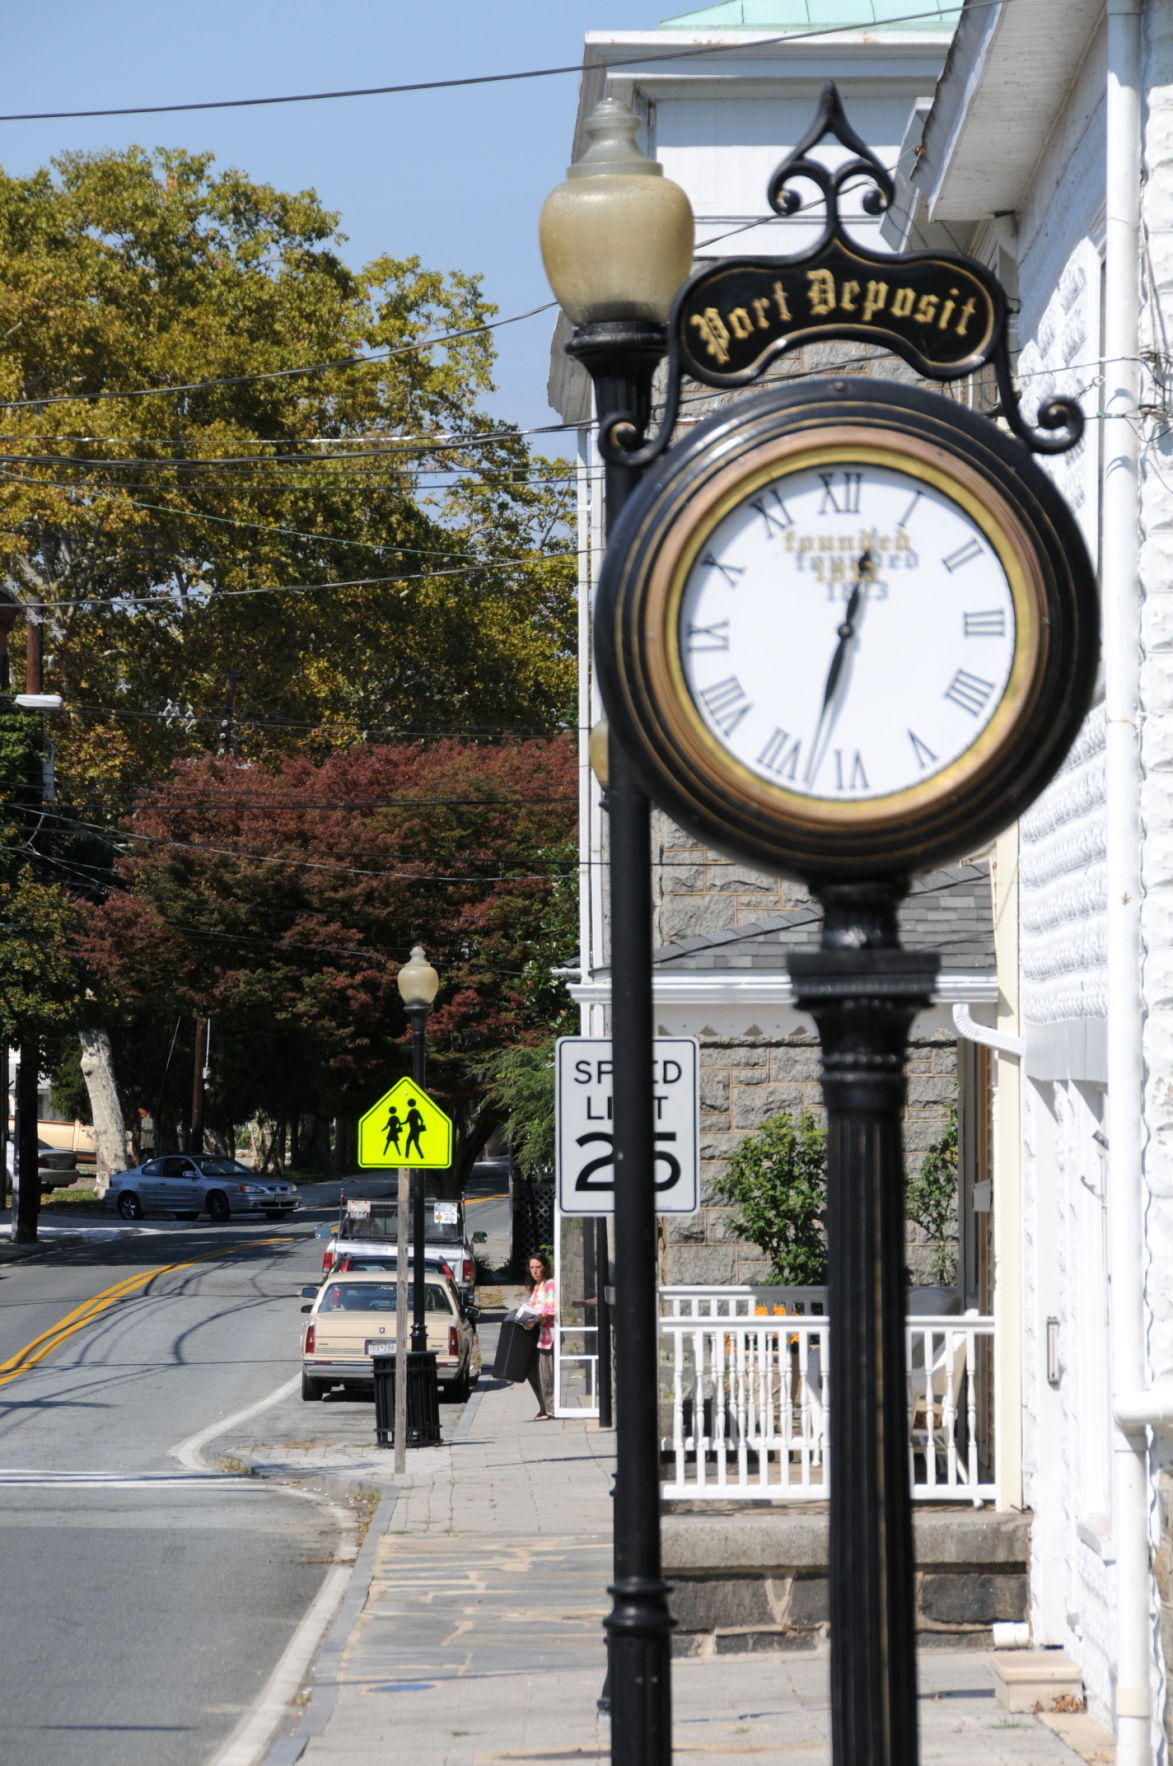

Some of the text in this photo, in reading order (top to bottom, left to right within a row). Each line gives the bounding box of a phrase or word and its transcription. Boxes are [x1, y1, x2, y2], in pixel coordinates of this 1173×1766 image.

[690, 268, 977, 364] Port Deposit
[817, 473, 865, 515] XII
[574, 1060, 682, 1084] SPD
[587, 1096, 669, 1120] LIT
[575, 1131, 682, 1192] 25
